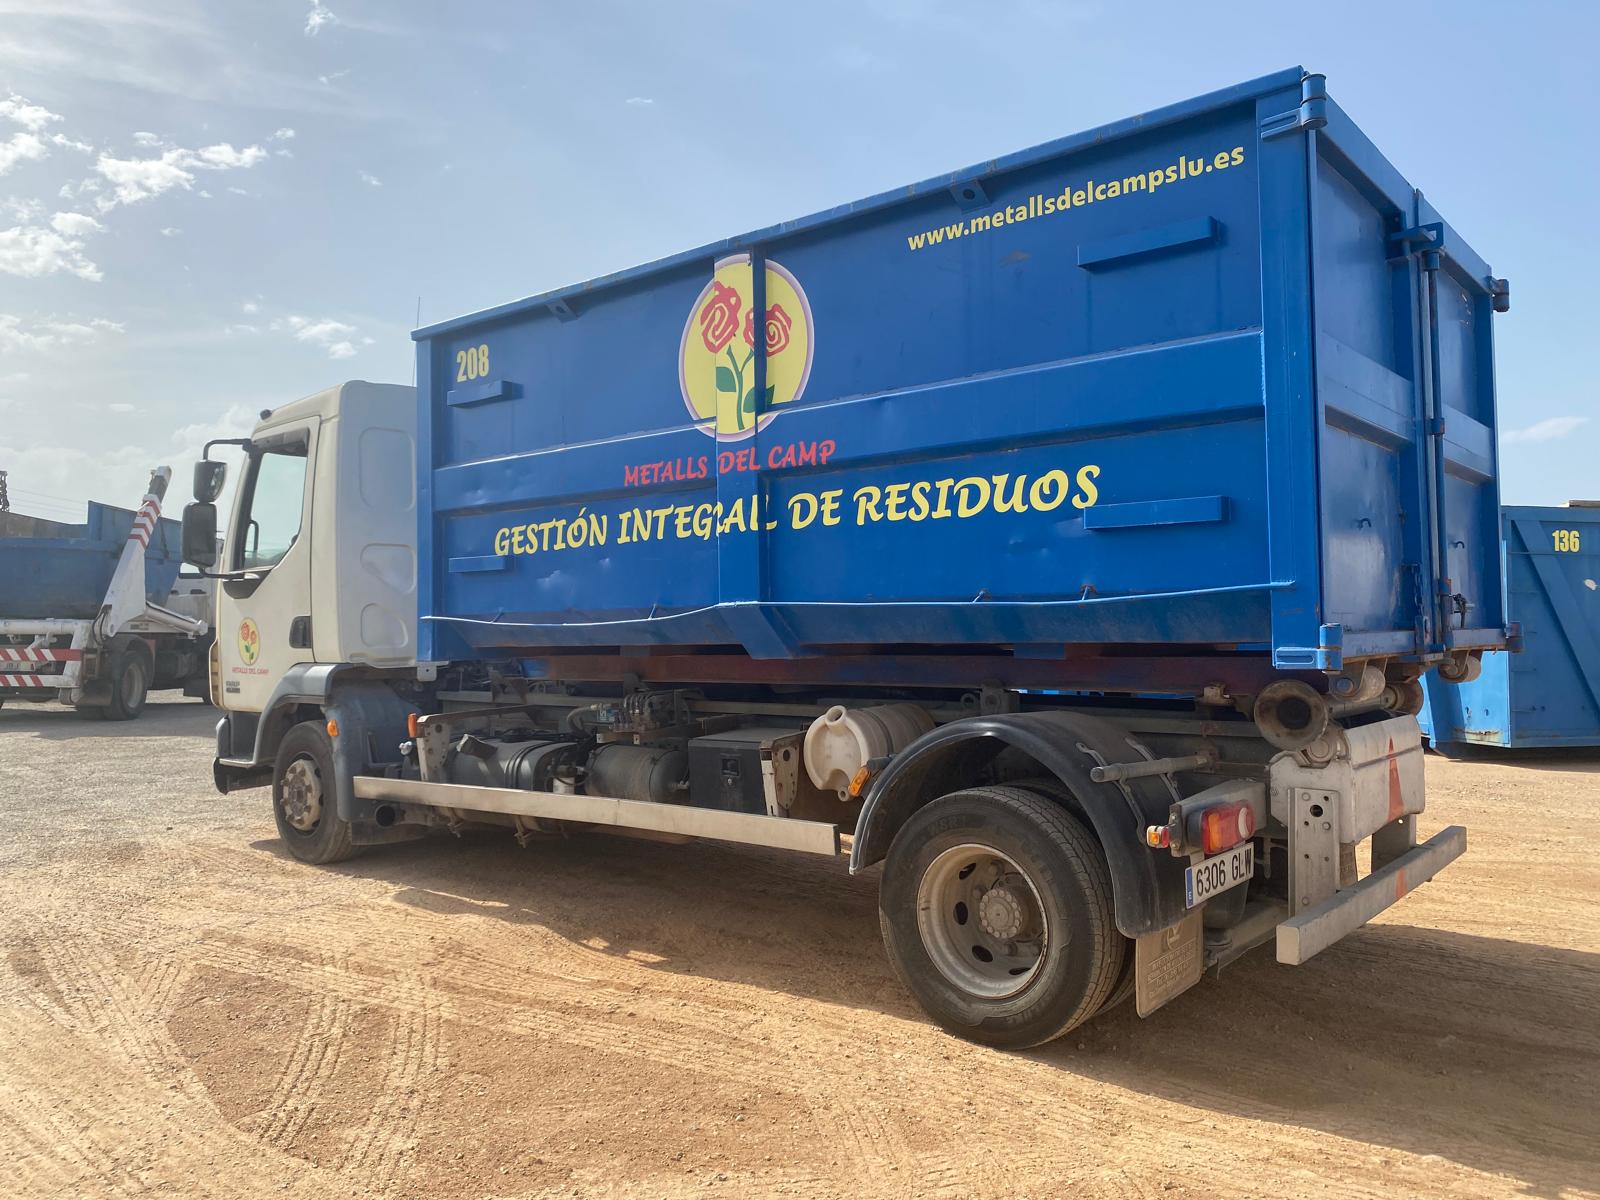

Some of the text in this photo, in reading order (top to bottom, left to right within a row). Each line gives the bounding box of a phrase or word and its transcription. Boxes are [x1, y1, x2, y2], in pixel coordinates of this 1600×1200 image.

[907, 146, 1245, 251] www.metallsdelcampslu.es
[456, 344, 490, 383] 208
[623, 438, 836, 487] METALLS DEL CAMP
[493, 463, 1101, 557] GESTIÓN INTEGRAL DE RESIDUOS
[1552, 529, 1581, 553] 136
[1196, 859, 1226, 897] 6306
[1231, 847, 1252, 881] GLW
